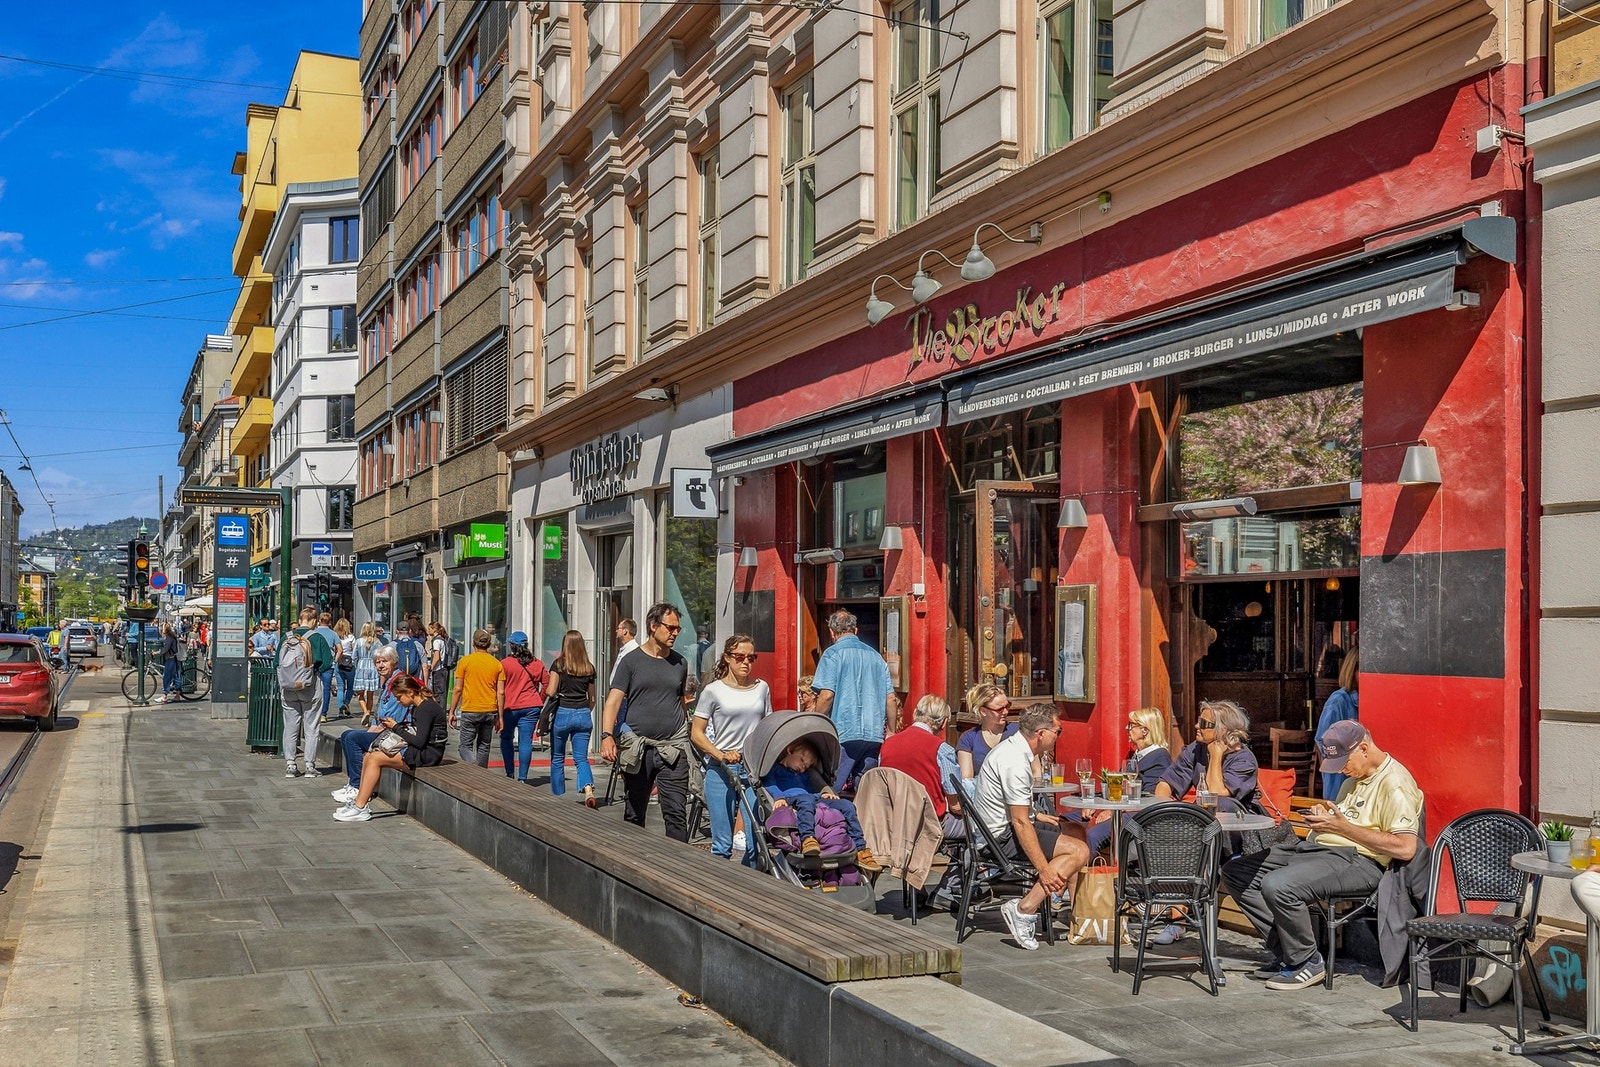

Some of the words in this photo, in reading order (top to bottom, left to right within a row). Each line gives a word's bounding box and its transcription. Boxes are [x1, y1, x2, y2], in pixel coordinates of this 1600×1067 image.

[958, 393, 1019, 415] HÅNDVERKSBRYGG
[1026, 380, 1070, 399] COCTAILBAR
[1079, 372, 1100, 387] EGET
[1101, 361, 1143, 380] BRENNERI
[1153, 338, 1234, 368] BROKER-BURGER
[1246, 312, 1328, 344] LUNSJ/MIDDAG
[1342, 299, 1382, 319] AFTER
[1386, 286, 1428, 308] WORK
[895, 417, 913, 429] AFTER
[914, 413, 931, 425] WORK
[478, 541, 503, 549] Musti
[359, 566, 386, 576] norli
[176, 585, 183, 595] P
